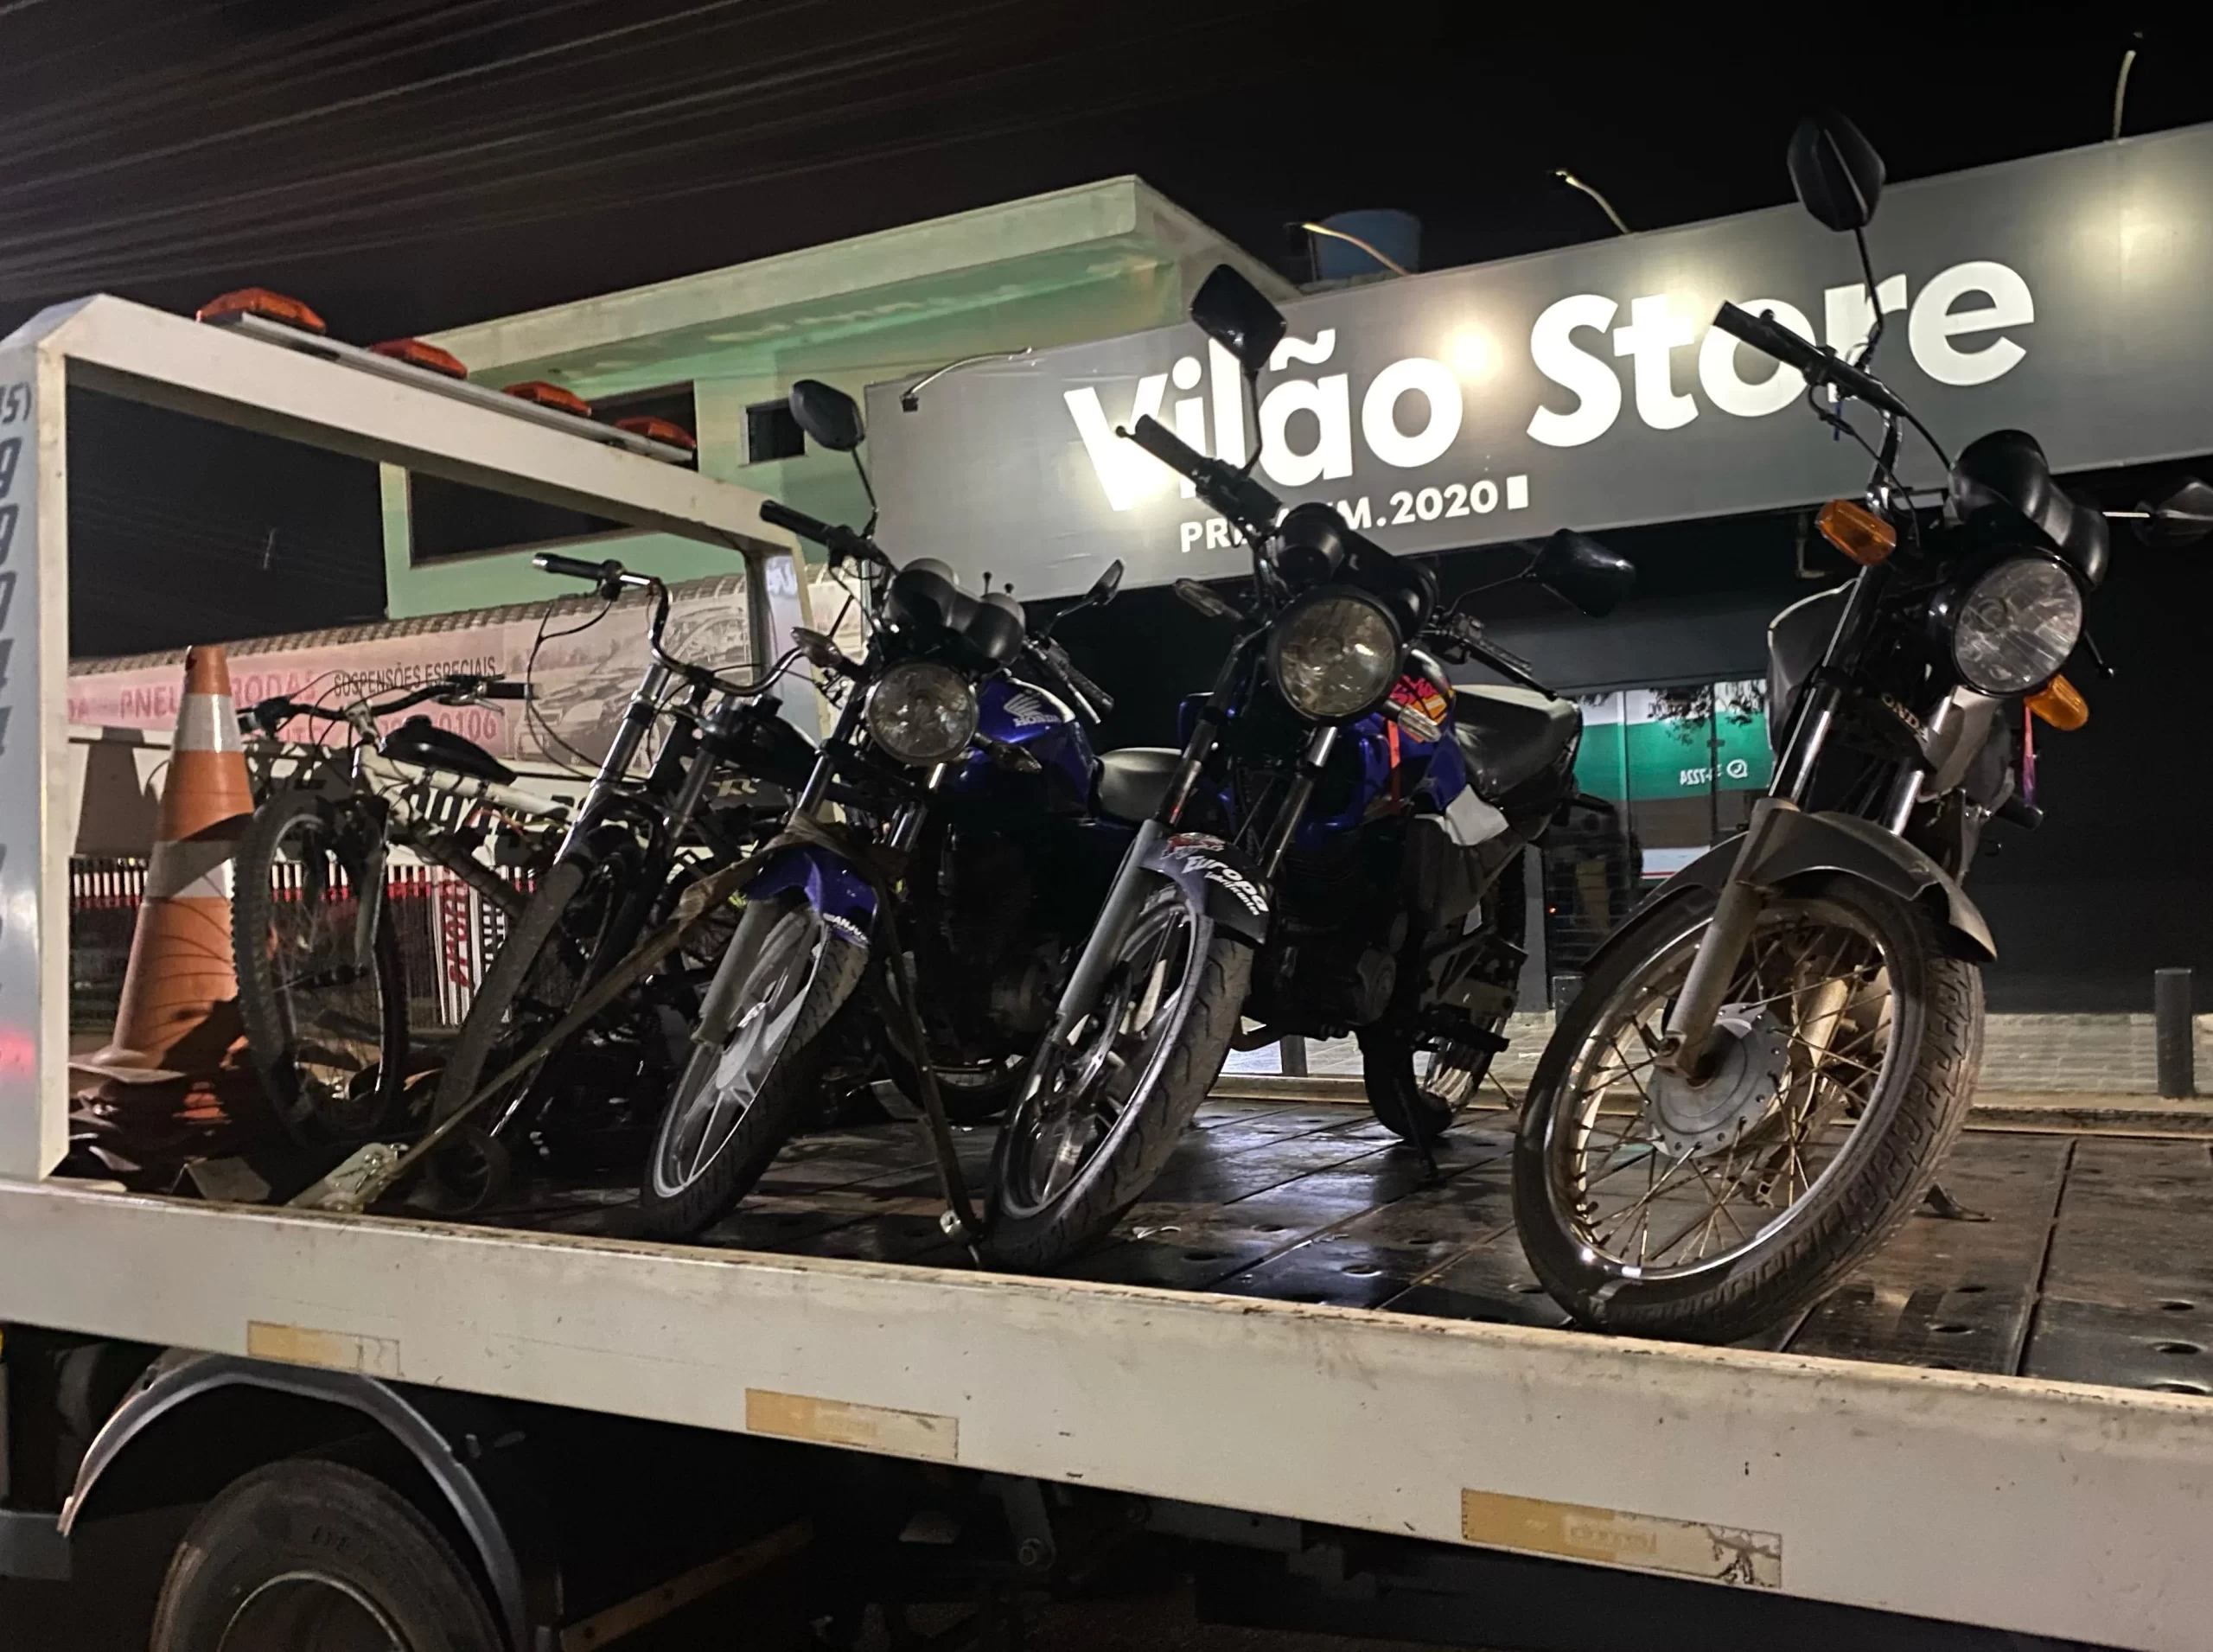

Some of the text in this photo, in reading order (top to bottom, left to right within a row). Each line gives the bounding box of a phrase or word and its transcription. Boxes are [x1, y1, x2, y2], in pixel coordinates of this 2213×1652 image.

[1064, 261, 2034, 512] Vilão Store
[1013, 714, 1062, 728] HONDA
